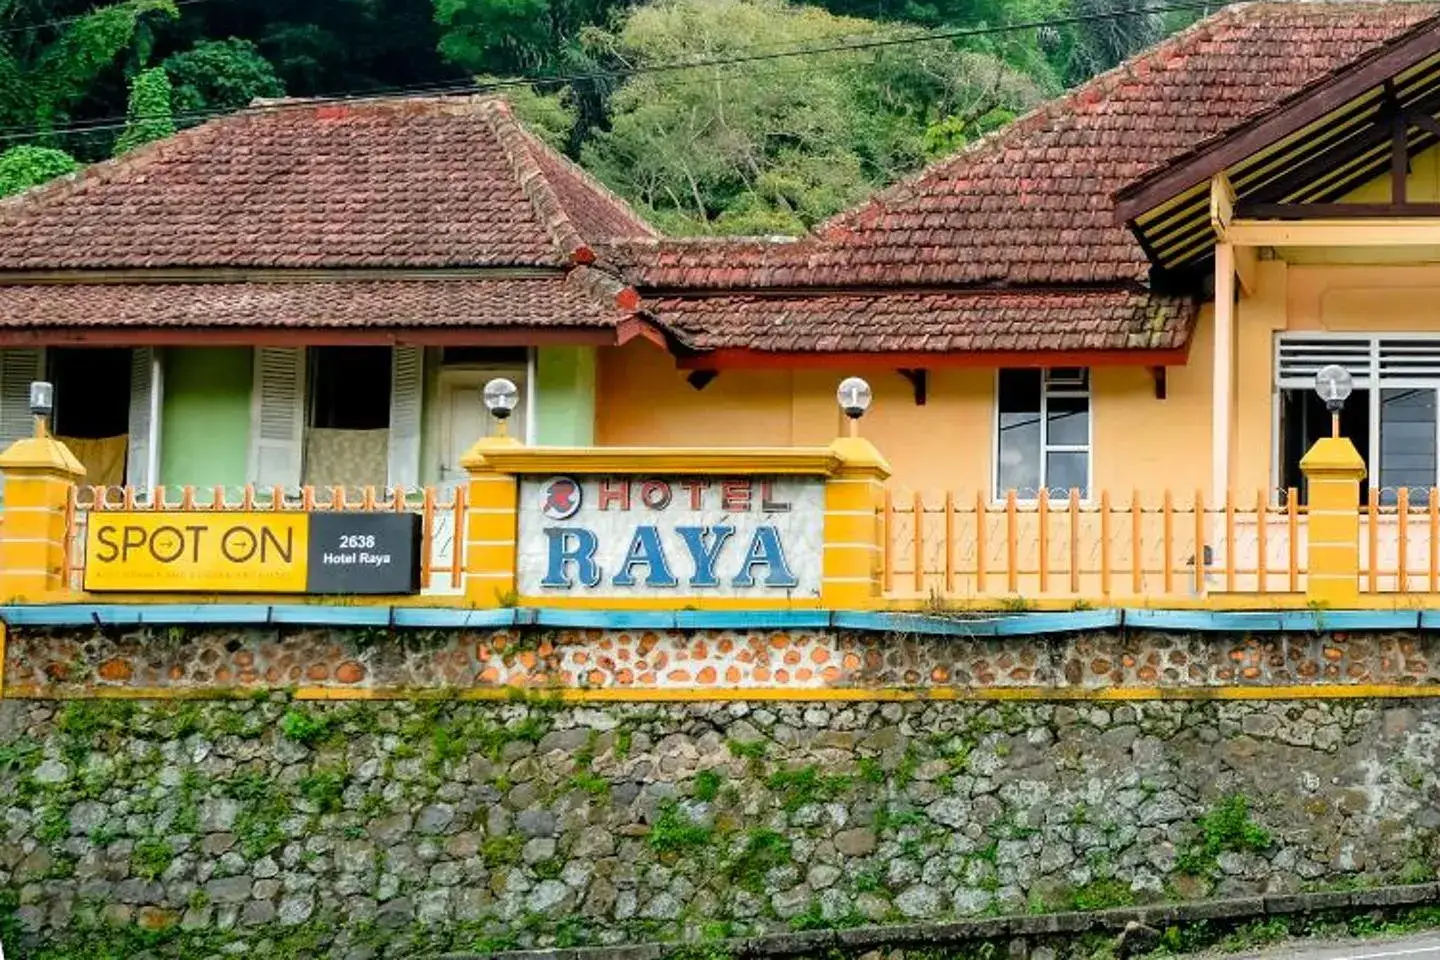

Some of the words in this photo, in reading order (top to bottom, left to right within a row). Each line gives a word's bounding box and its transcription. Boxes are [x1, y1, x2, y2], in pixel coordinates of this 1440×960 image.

[598, 480, 791, 513] HOTEL
[96, 526, 208, 563] SPOT
[221, 526, 293, 563] ON
[339, 535, 375, 548] 2638
[540, 525, 799, 588] RAYA
[323, 553, 356, 564] Hotel
[360, 553, 391, 567] Raya
